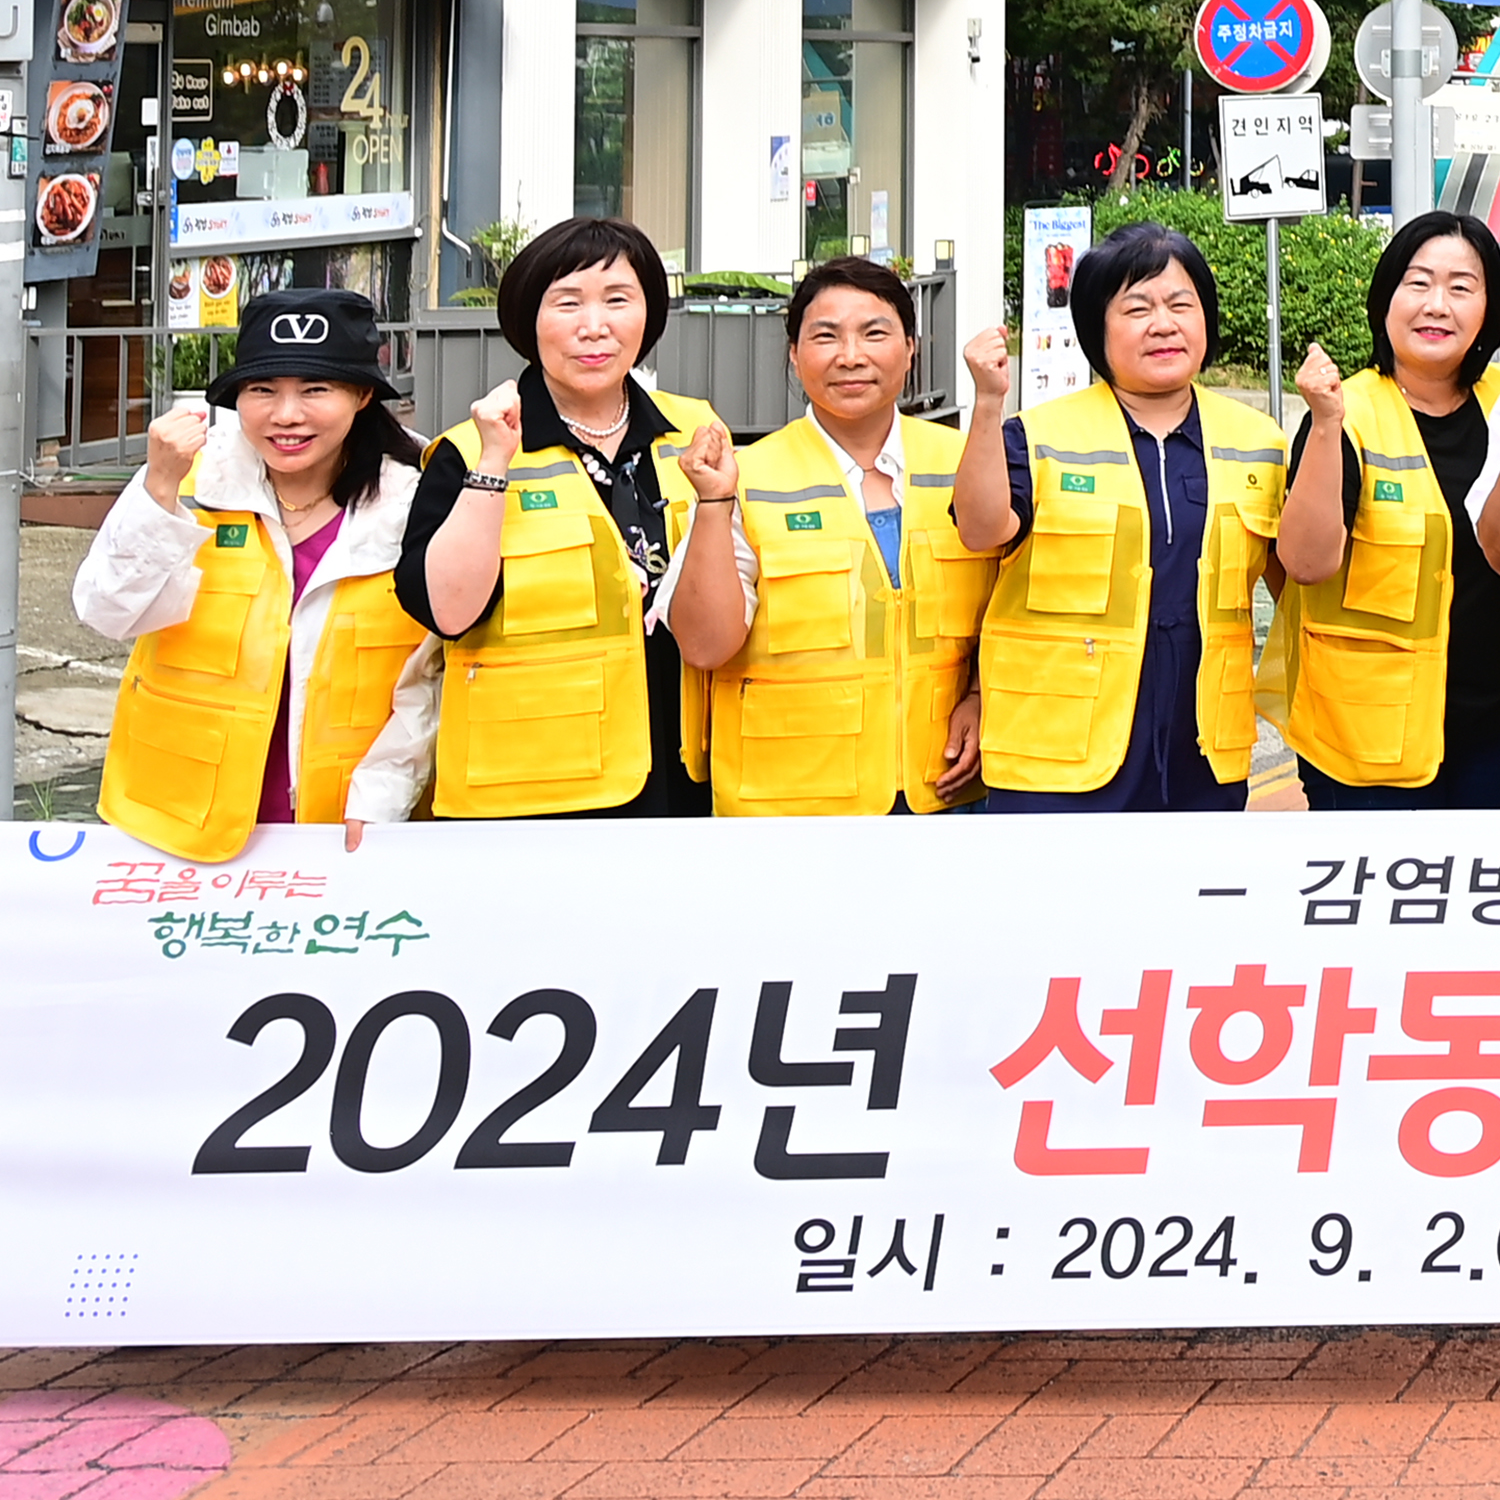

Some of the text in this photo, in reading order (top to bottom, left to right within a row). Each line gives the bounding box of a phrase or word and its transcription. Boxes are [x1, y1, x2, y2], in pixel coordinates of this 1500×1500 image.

[205, 13, 260, 38] Gimbab
[1217, 19, 1293, 42] 주정차금지
[341, 36, 384, 129] 24
[1232, 115, 1314, 138] 견인지역
[352, 134, 403, 165] OPEN
[1033, 219, 1050, 231] The
[93, 861, 327, 905] 꿈을 이루는
[147, 910, 430, 959] 행복한 연수
[192, 973, 918, 1180] 2024년
[795, 1214, 944, 1292] 일시
[1052, 1216, 1258, 1283] 2024.
[1310, 1214, 1371, 1281] 9.
